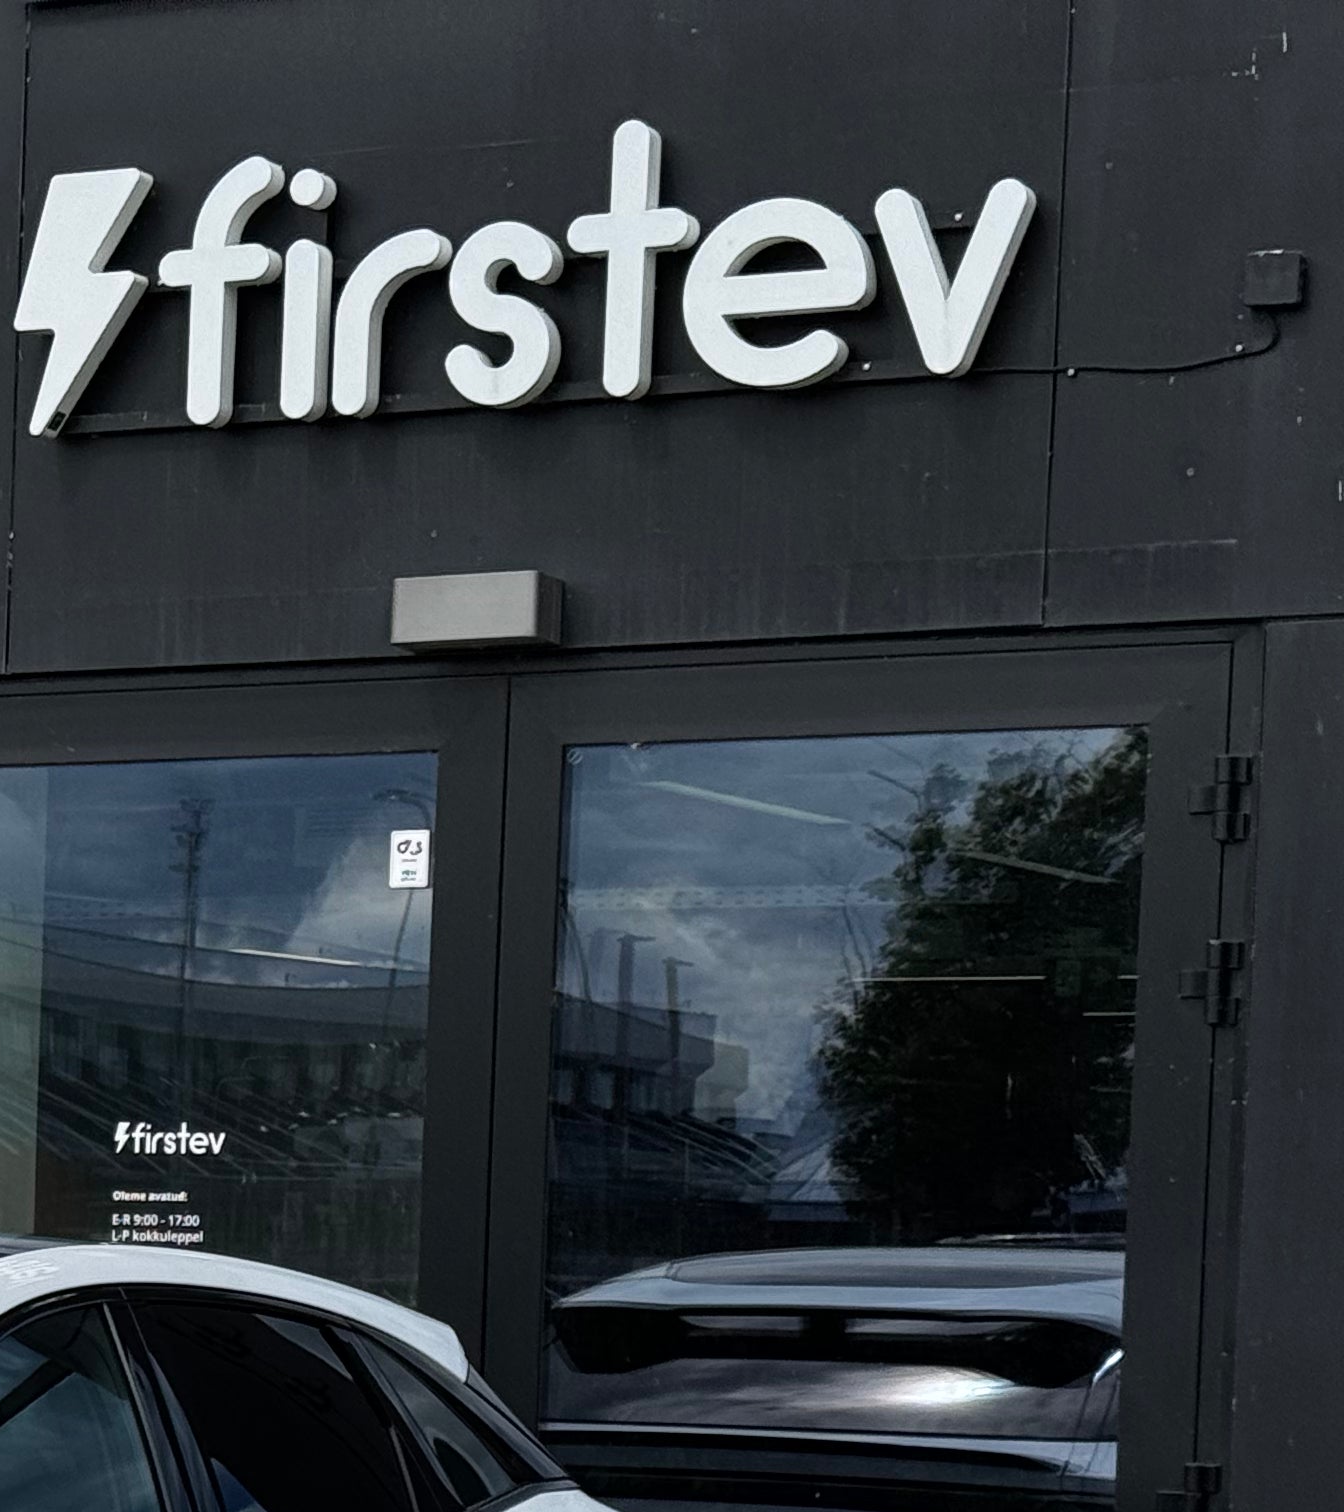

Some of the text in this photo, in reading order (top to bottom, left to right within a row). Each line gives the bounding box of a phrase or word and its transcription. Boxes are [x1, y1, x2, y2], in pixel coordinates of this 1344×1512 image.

[158, 119, 1036, 428] firstev
[131, 1121, 226, 1155] firstev
[112, 1190, 147, 1202] Oleme
[133, 1213, 158, 1227] 9:00
[168, 1214, 200, 1228] 17:00
[132, 1230, 204, 1246] kokkuleppel
